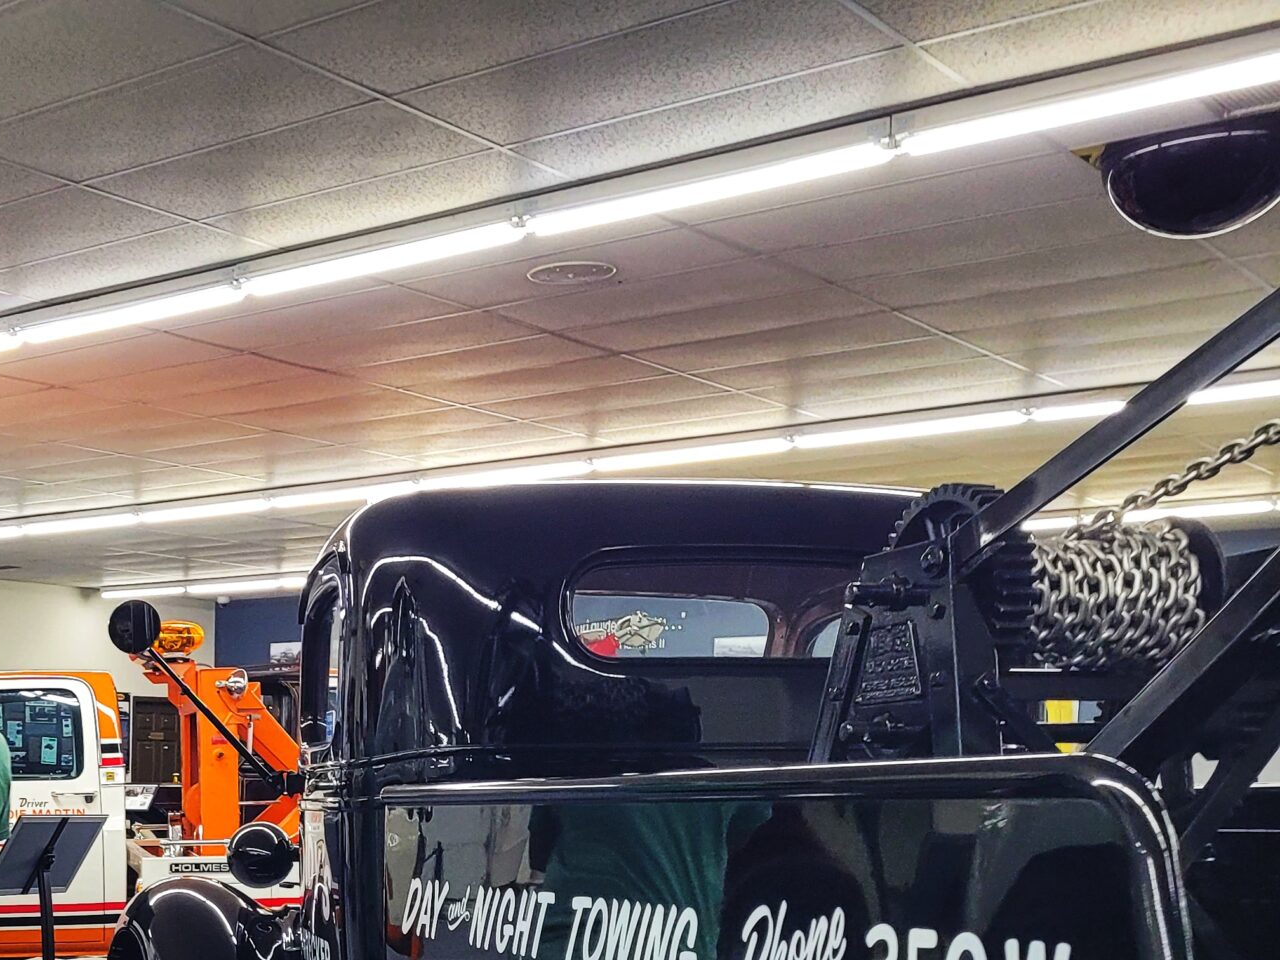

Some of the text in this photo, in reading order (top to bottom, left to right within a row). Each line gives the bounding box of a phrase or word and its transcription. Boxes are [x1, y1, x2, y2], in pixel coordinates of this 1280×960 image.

[19, 797, 49, 808] Driver
[171, 863, 229, 872] HOLMES
[401, 877, 450, 940] DAY
[447, 885, 470, 931] and
[469, 885, 556, 959] NIGHT
